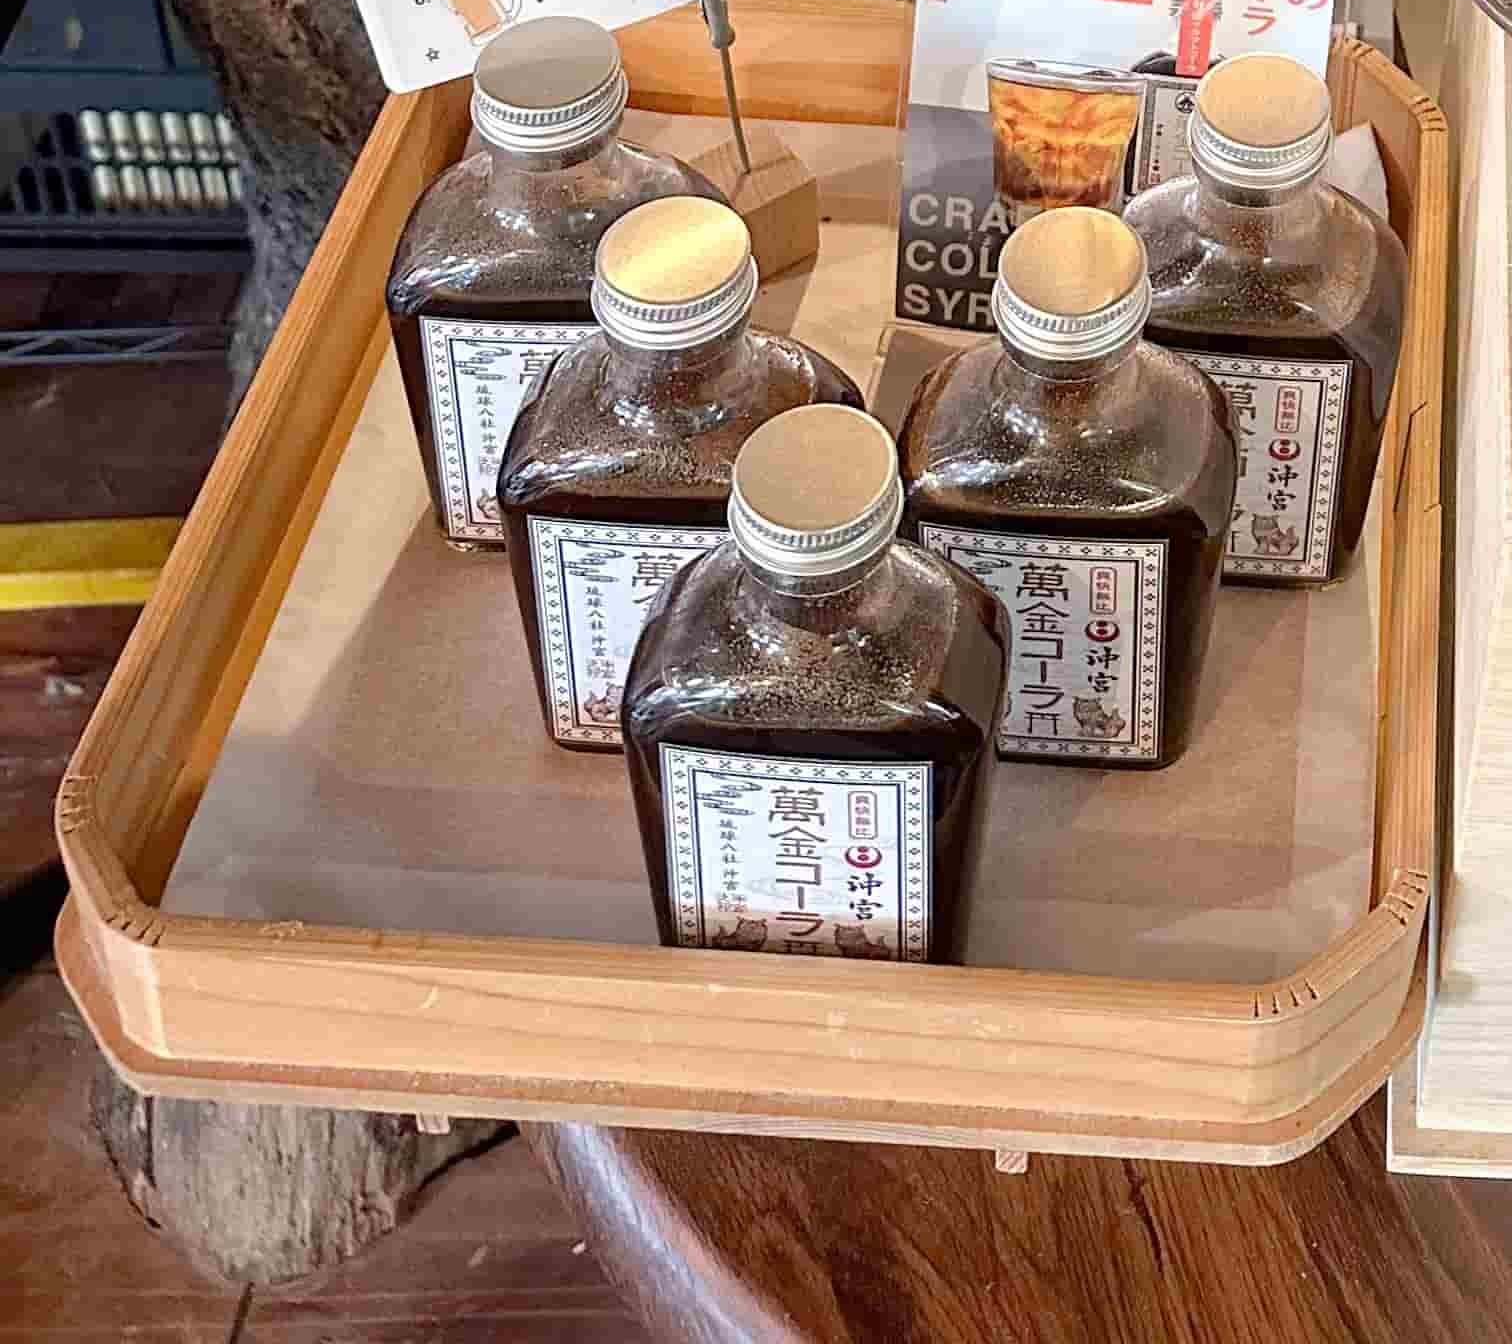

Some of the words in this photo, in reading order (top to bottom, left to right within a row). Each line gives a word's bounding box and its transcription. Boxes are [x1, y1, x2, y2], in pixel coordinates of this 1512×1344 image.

[907, 191, 1014, 234] CRA
[902, 238, 998, 280] COL
[902, 282, 995, 326] SYR
[1015, 561, 1072, 710] 萬金コーラ
[767, 785, 830, 938] 萬金コーラ
